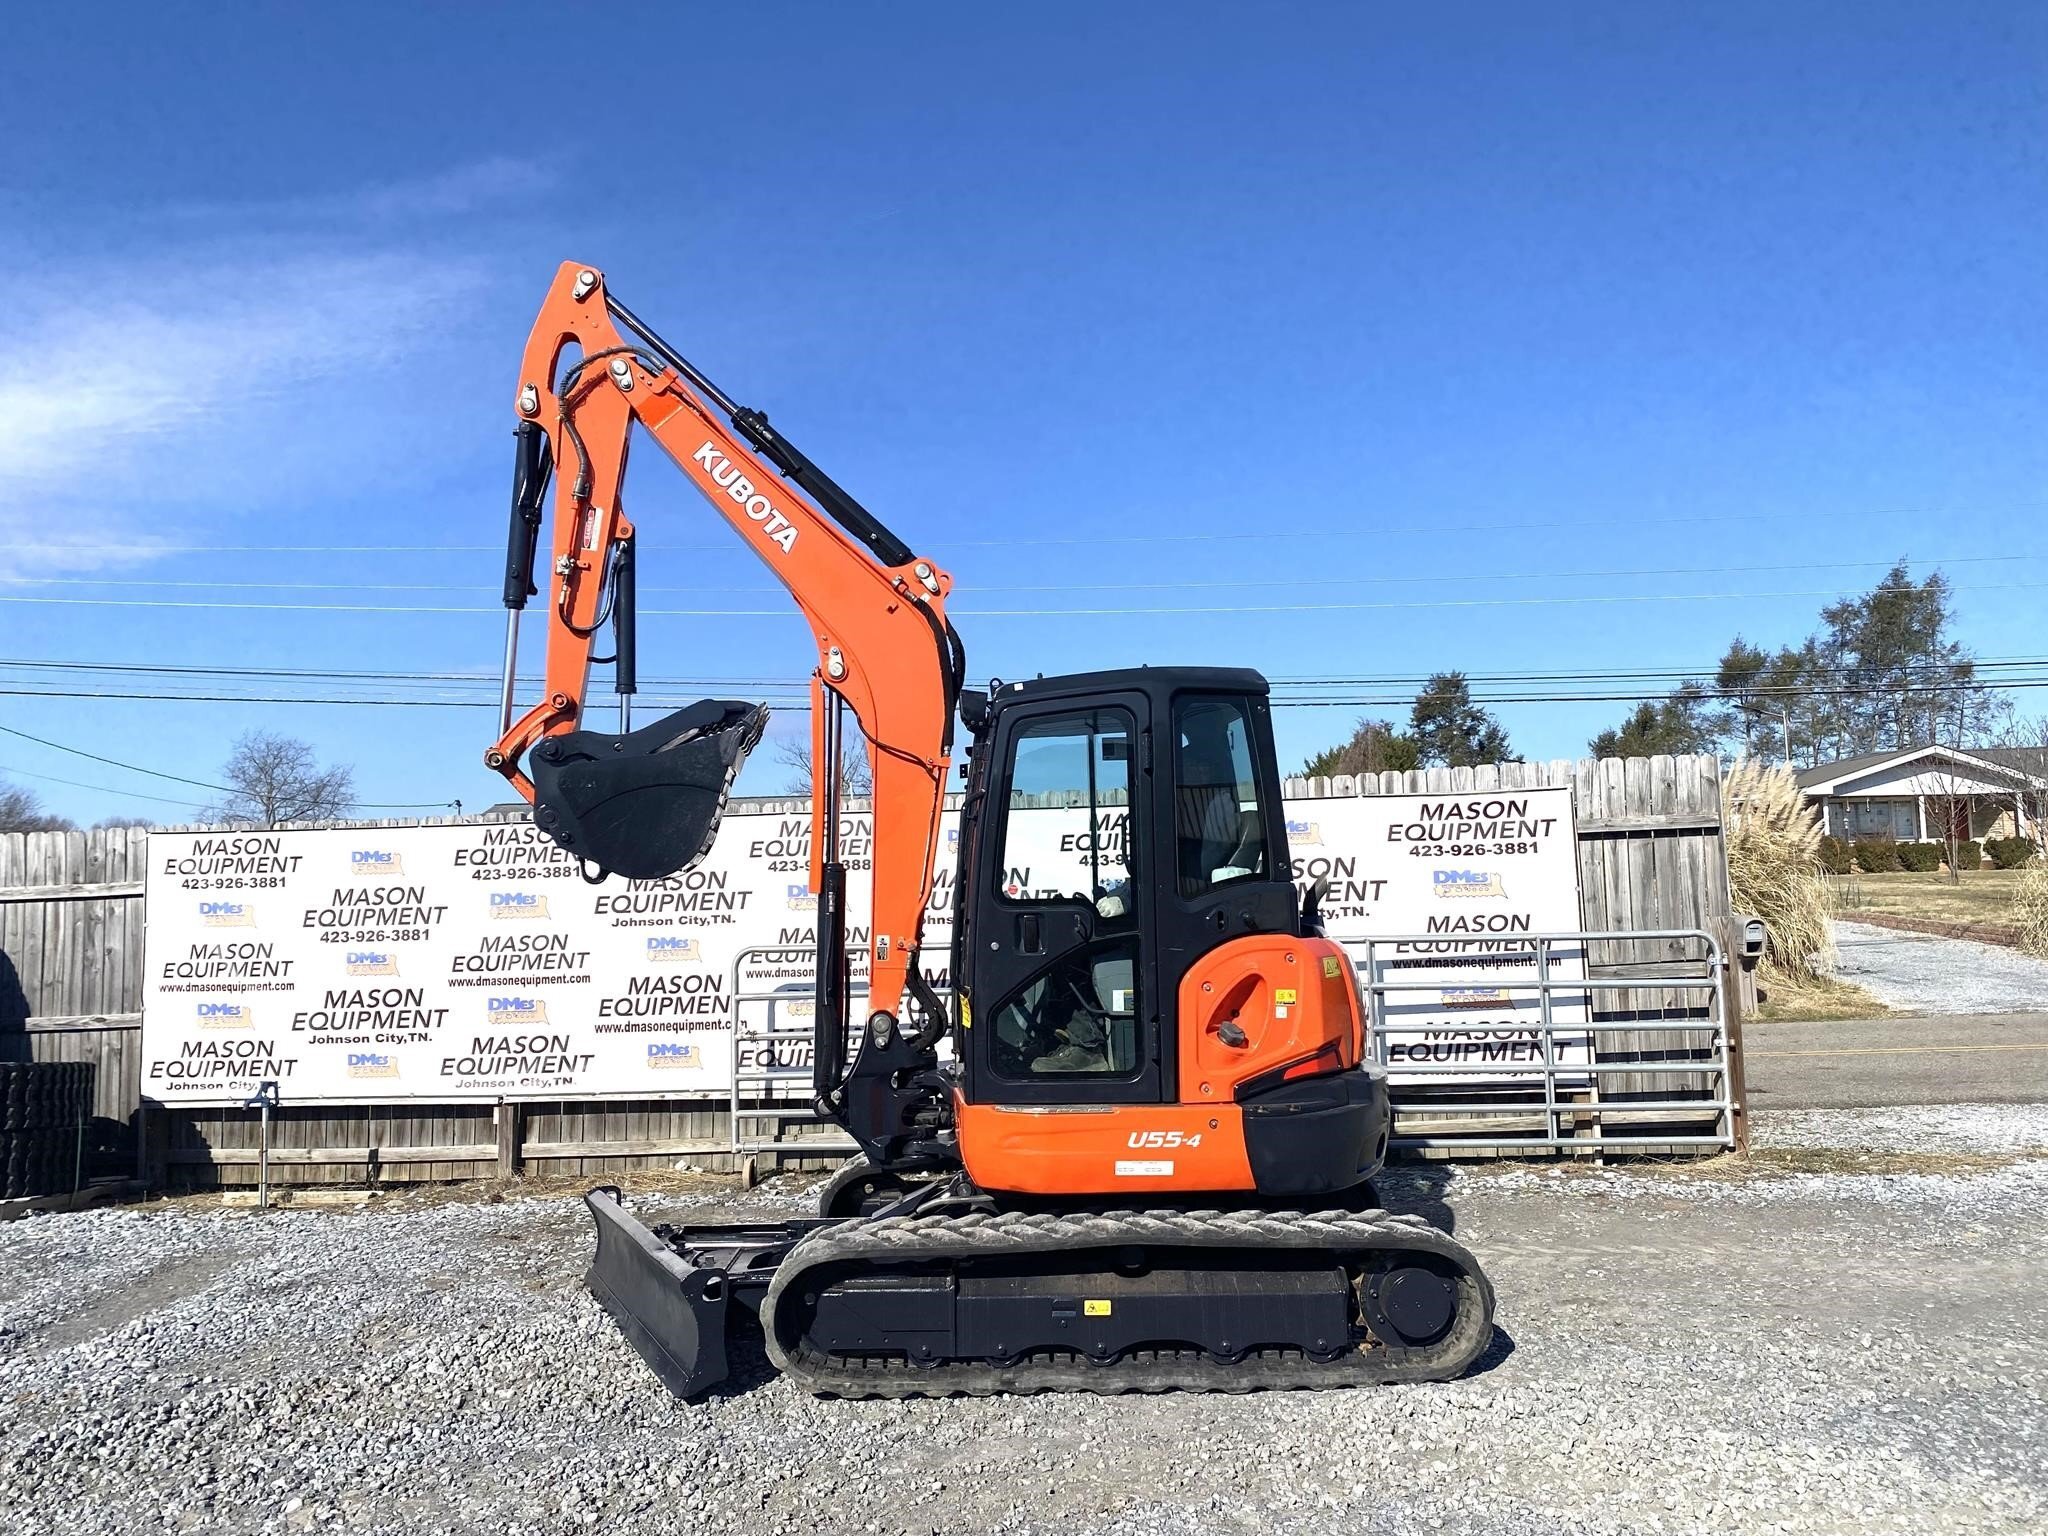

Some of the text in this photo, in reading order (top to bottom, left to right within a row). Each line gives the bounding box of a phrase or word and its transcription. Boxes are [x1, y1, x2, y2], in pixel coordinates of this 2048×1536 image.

[692, 440, 799, 555] KUBOTA
[1419, 799, 1528, 822] MASON
[1387, 819, 1557, 842] EQUIPMENT
[192, 838, 281, 856] MASON
[1409, 841, 1538, 857] 423-926-3881
[164, 856, 303, 875] EQUIPMENT
[472, 865, 580, 881] 423-926-3881
[181, 876, 286, 890] 423-926-3881
[626, 871, 728, 892] MASON
[332, 886, 425, 906] MASON
[594, 891, 753, 914] EQUIPMENT
[302, 906, 448, 928] EQUIPMENT
[611, 914, 736, 927] Johnson City,TN.
[1426, 914, 1531, 934] MASON
[320, 929, 430, 943] 423-926-3881
[480, 934, 568, 953] MASON
[190, 943, 273, 960] MASON
[163, 960, 293, 979] EQUIPMENT
[452, 952, 590, 973] EQUIPMENT
[159, 981, 295, 995] www.dmasonequipment.com
[448, 974, 591, 988] www.dmasonequipment.com
[628, 974, 723, 996] MASON
[324, 988, 424, 1009] MASON
[598, 994, 730, 1018] EQUIPMEN
[291, 1009, 449, 1031] EQUIPMENT
[308, 1033, 433, 1045] Johnson City,TN.
[471, 1035, 570, 1055] MASON
[181, 1040, 274, 1059] MASON
[1389, 1041, 1571, 1062] EQUIPMENT
[150, 1060, 298, 1079] EQUIPMENT
[440, 1054, 595, 1076] EQUIPMENT
[166, 1081, 224, 1091] Johnson
[455, 1077, 576, 1089] Johnson City,TN.
[1127, 1131, 1202, 1148] U55-4
